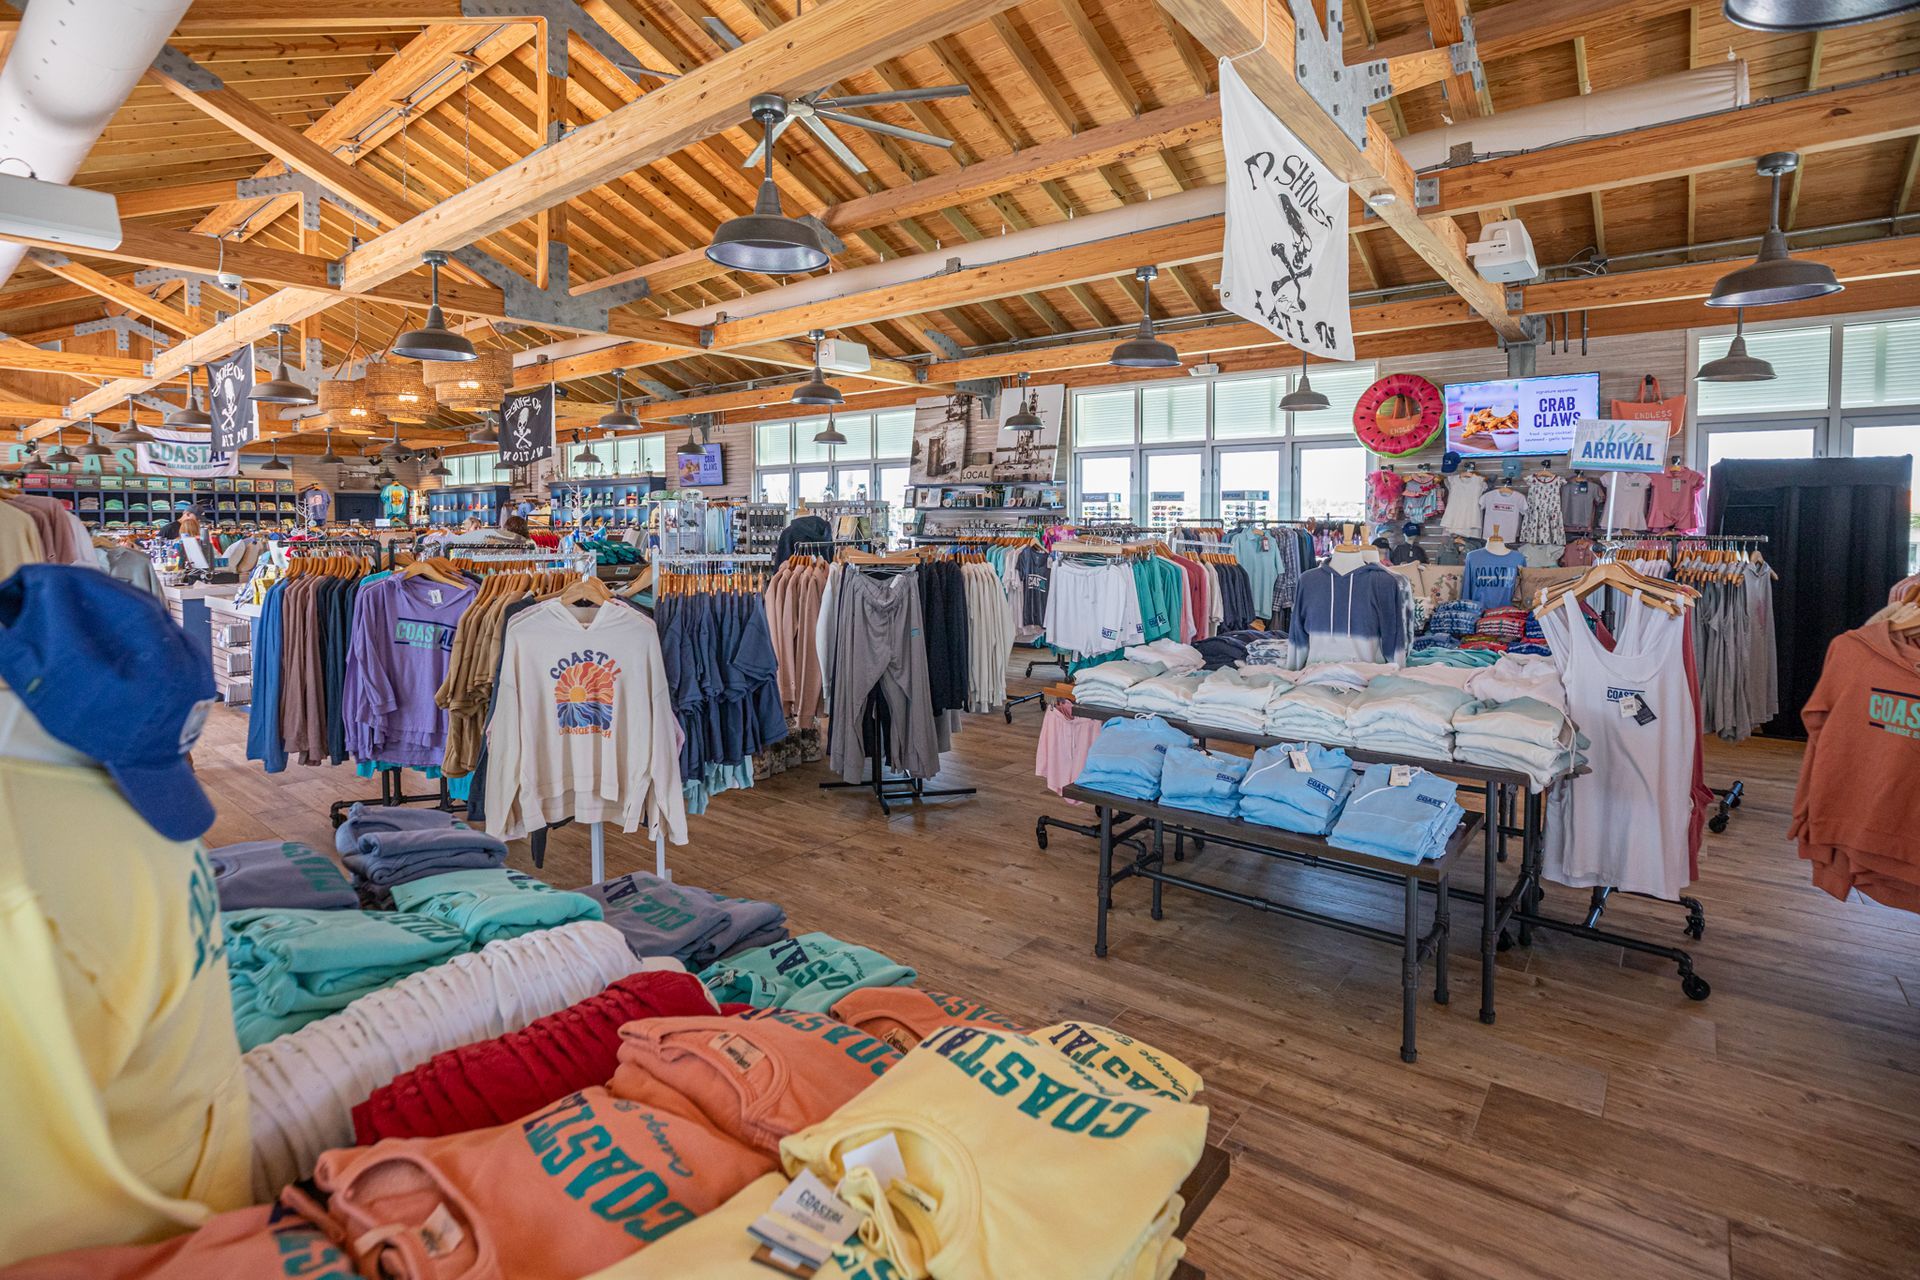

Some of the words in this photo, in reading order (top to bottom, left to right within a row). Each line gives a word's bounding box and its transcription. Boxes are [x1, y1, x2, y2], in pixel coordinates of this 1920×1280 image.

[1539, 396, 1576, 413] CRAB
[1634, 409, 1672, 420] ENDLESS
[1533, 411, 1581, 428] CLAWS
[1599, 422, 1645, 444] New
[1581, 441, 1655, 461] ARRIVAL
[962, 470, 989, 480] LOCAL
[549, 649, 622, 681] COASTAL
[1869, 693, 1920, 729] COAS
[920, 1025, 1152, 1139] COASTAL
